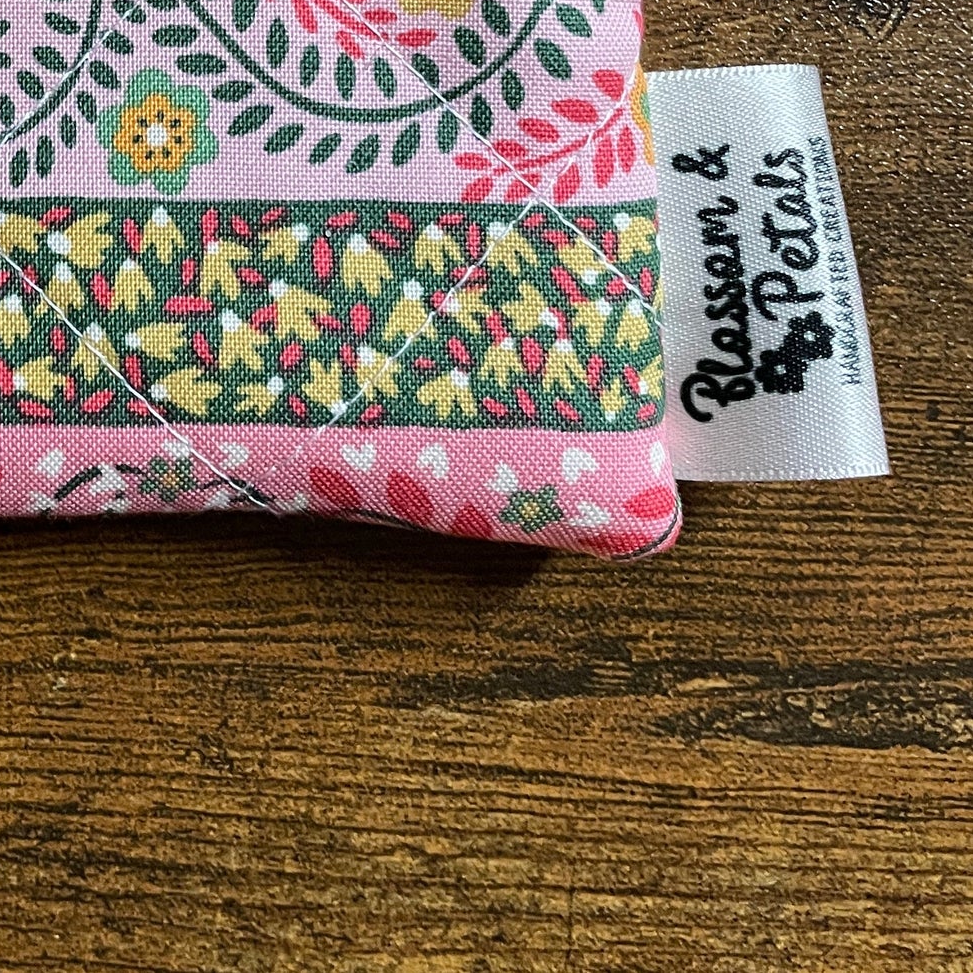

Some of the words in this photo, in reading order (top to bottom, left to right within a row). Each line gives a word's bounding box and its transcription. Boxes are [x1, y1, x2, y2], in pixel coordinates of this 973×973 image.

[671, 144, 731, 182] &
[808, 135, 843, 243] CREATIONS
[751, 147, 824, 321] Petals
[680, 195, 758, 423] Blossom
[828, 250, 861, 386] HANDCRAFTED
